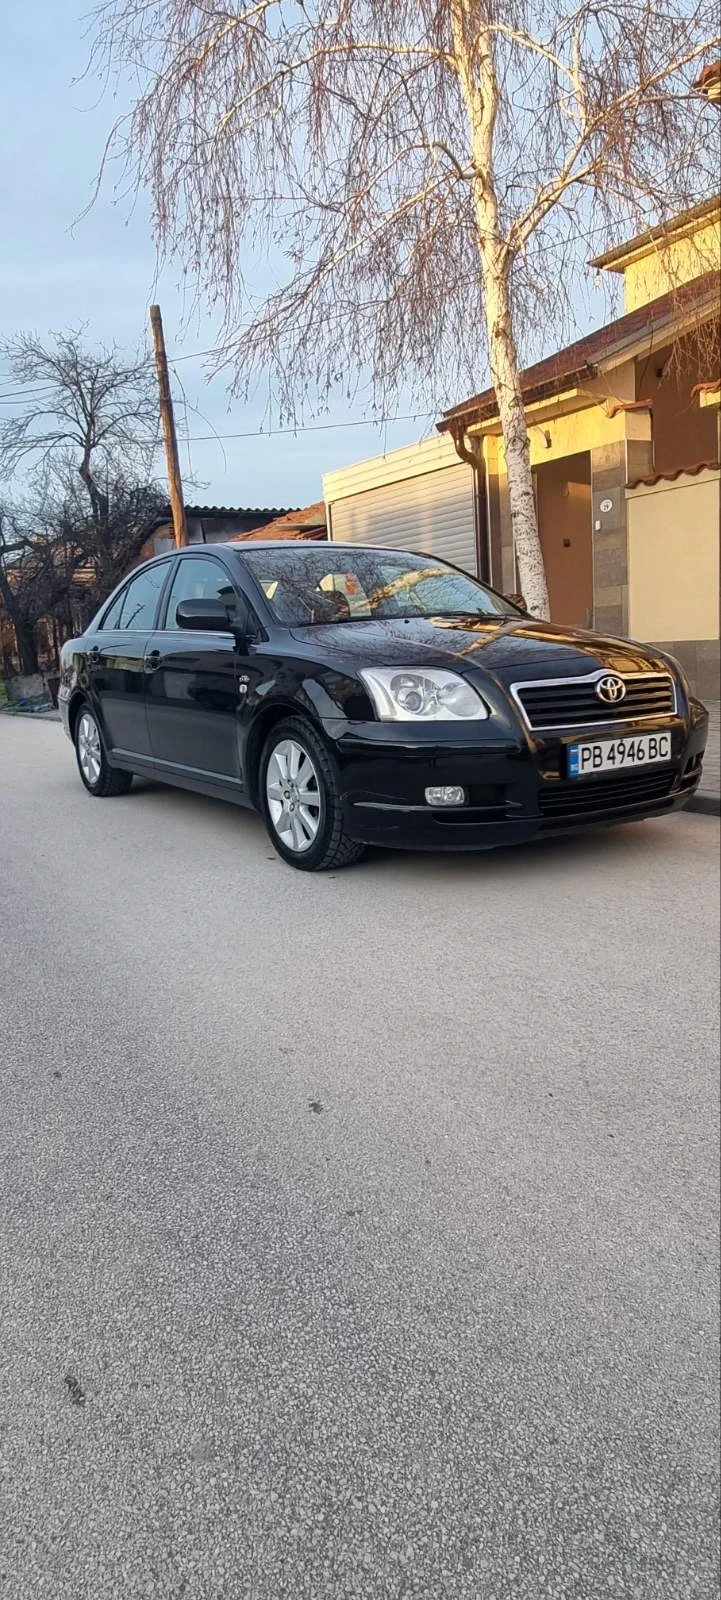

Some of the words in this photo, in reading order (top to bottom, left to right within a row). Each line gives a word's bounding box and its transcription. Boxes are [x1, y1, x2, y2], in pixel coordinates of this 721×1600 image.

[581, 745, 602, 770] PB
[607, 739, 645, 765] 4946
[648, 736, 669, 760] BC
